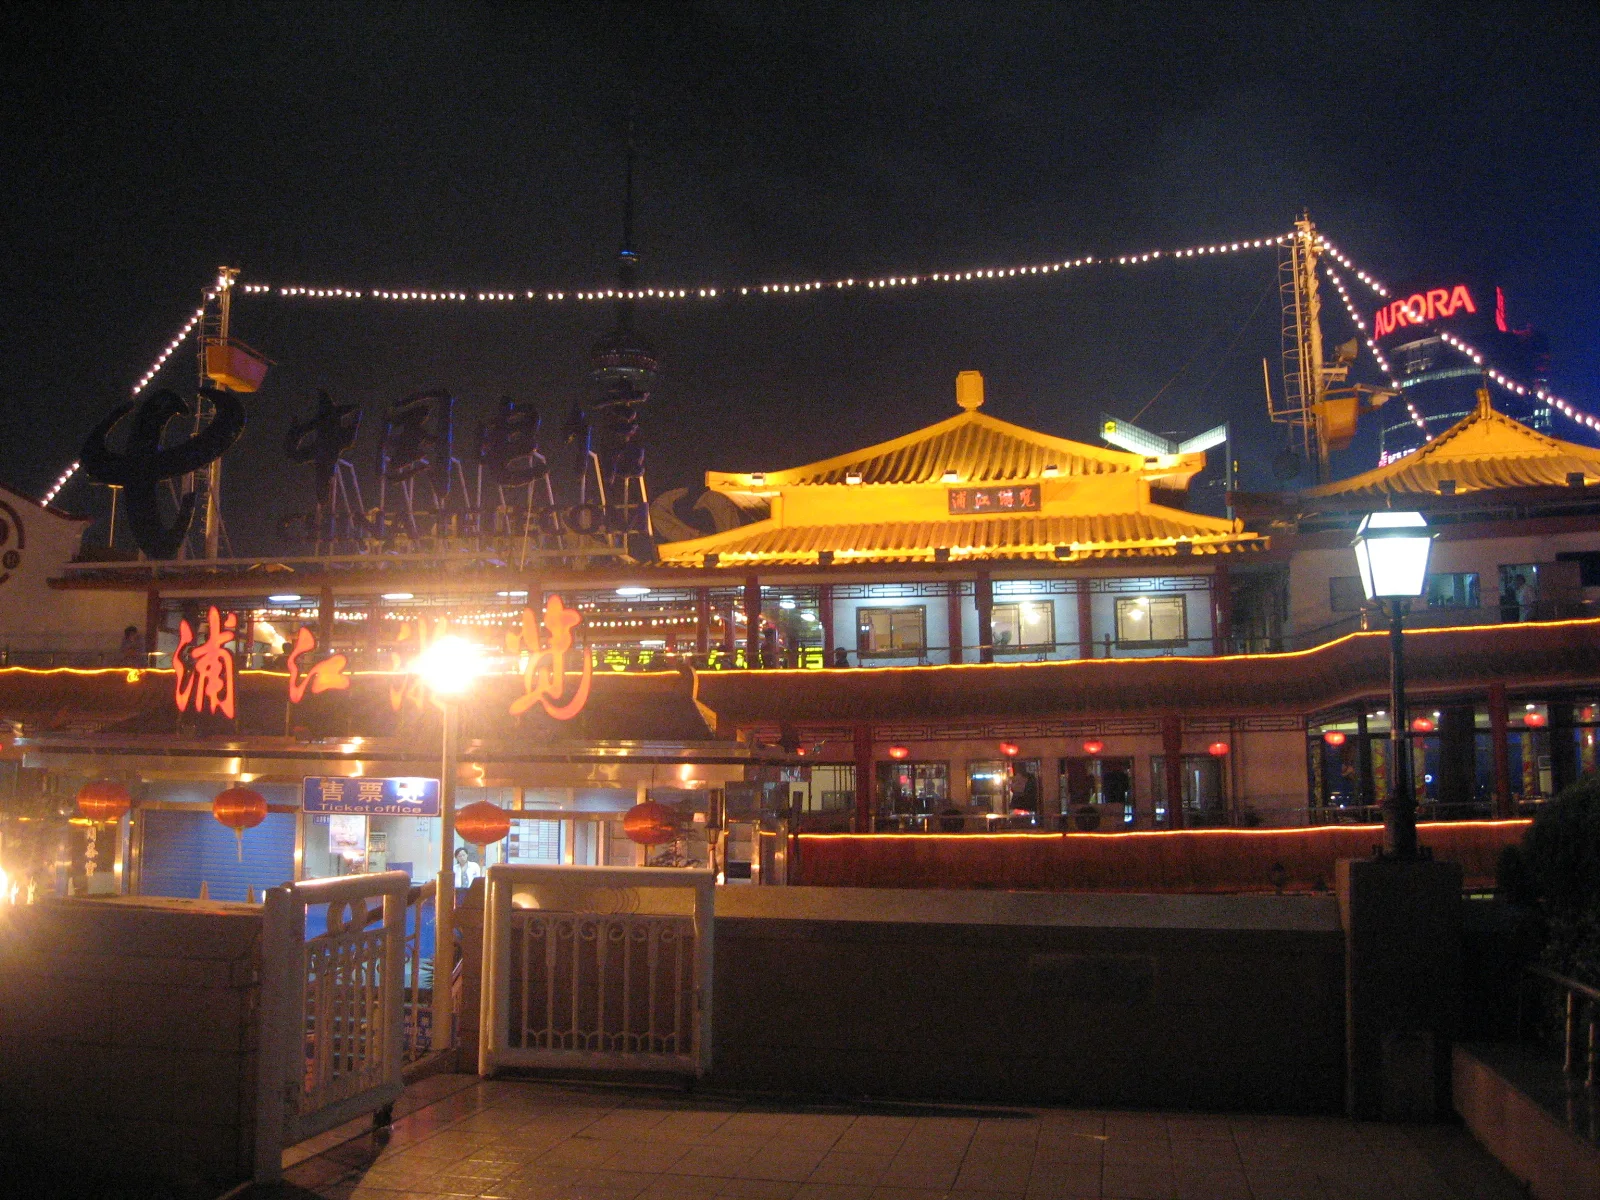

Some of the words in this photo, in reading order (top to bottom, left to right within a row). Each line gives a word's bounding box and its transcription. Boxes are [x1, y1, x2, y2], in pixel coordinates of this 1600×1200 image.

[1374, 284, 1476, 341] AURORA
[317, 780, 425, 804] 售票处
[318, 803, 371, 813] Ticket
[374, 804, 423, 814] office
